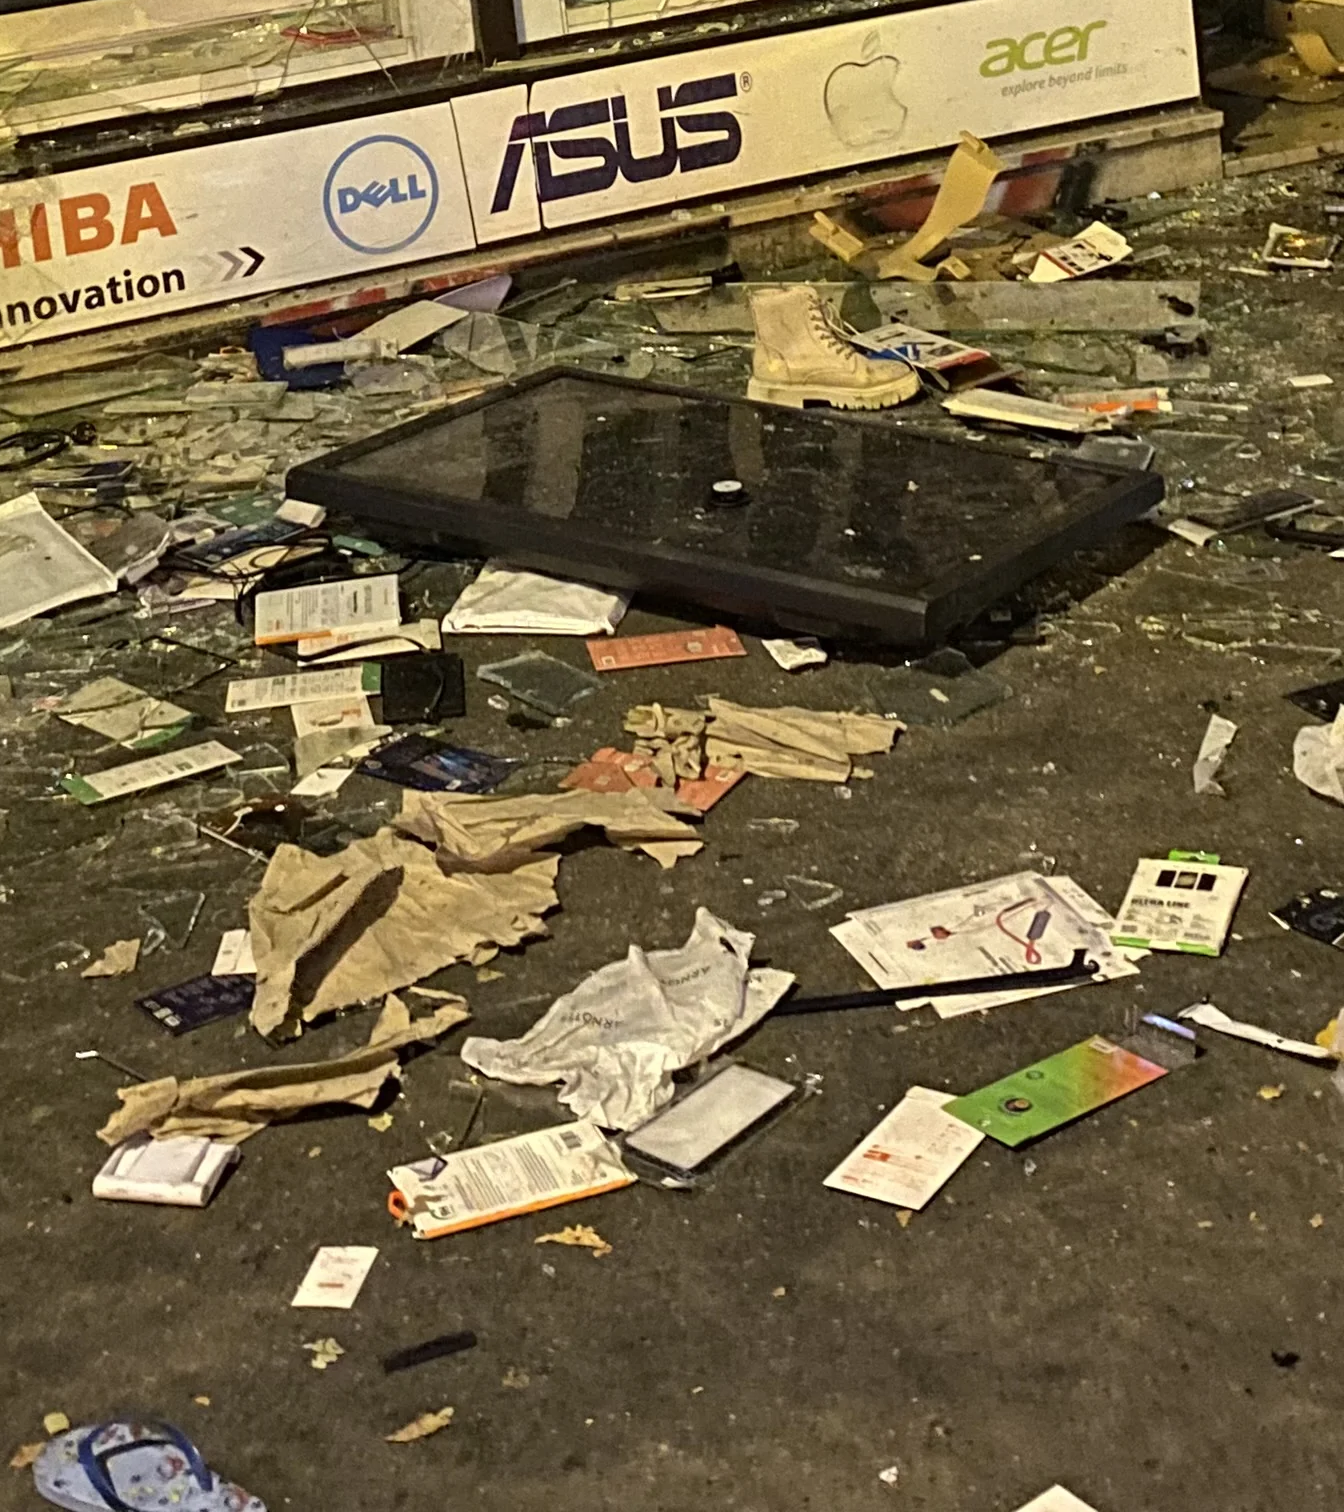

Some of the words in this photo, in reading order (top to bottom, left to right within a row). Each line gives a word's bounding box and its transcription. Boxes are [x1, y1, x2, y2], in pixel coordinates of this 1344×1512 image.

[978, 19, 1108, 79] acer
[999, 76, 1046, 98] explore
[1046, 65, 1092, 93] beyond
[1092, 60, 1129, 82] limits
[490, 72, 743, 215] ASUS
[337, 173, 428, 216] DELL
